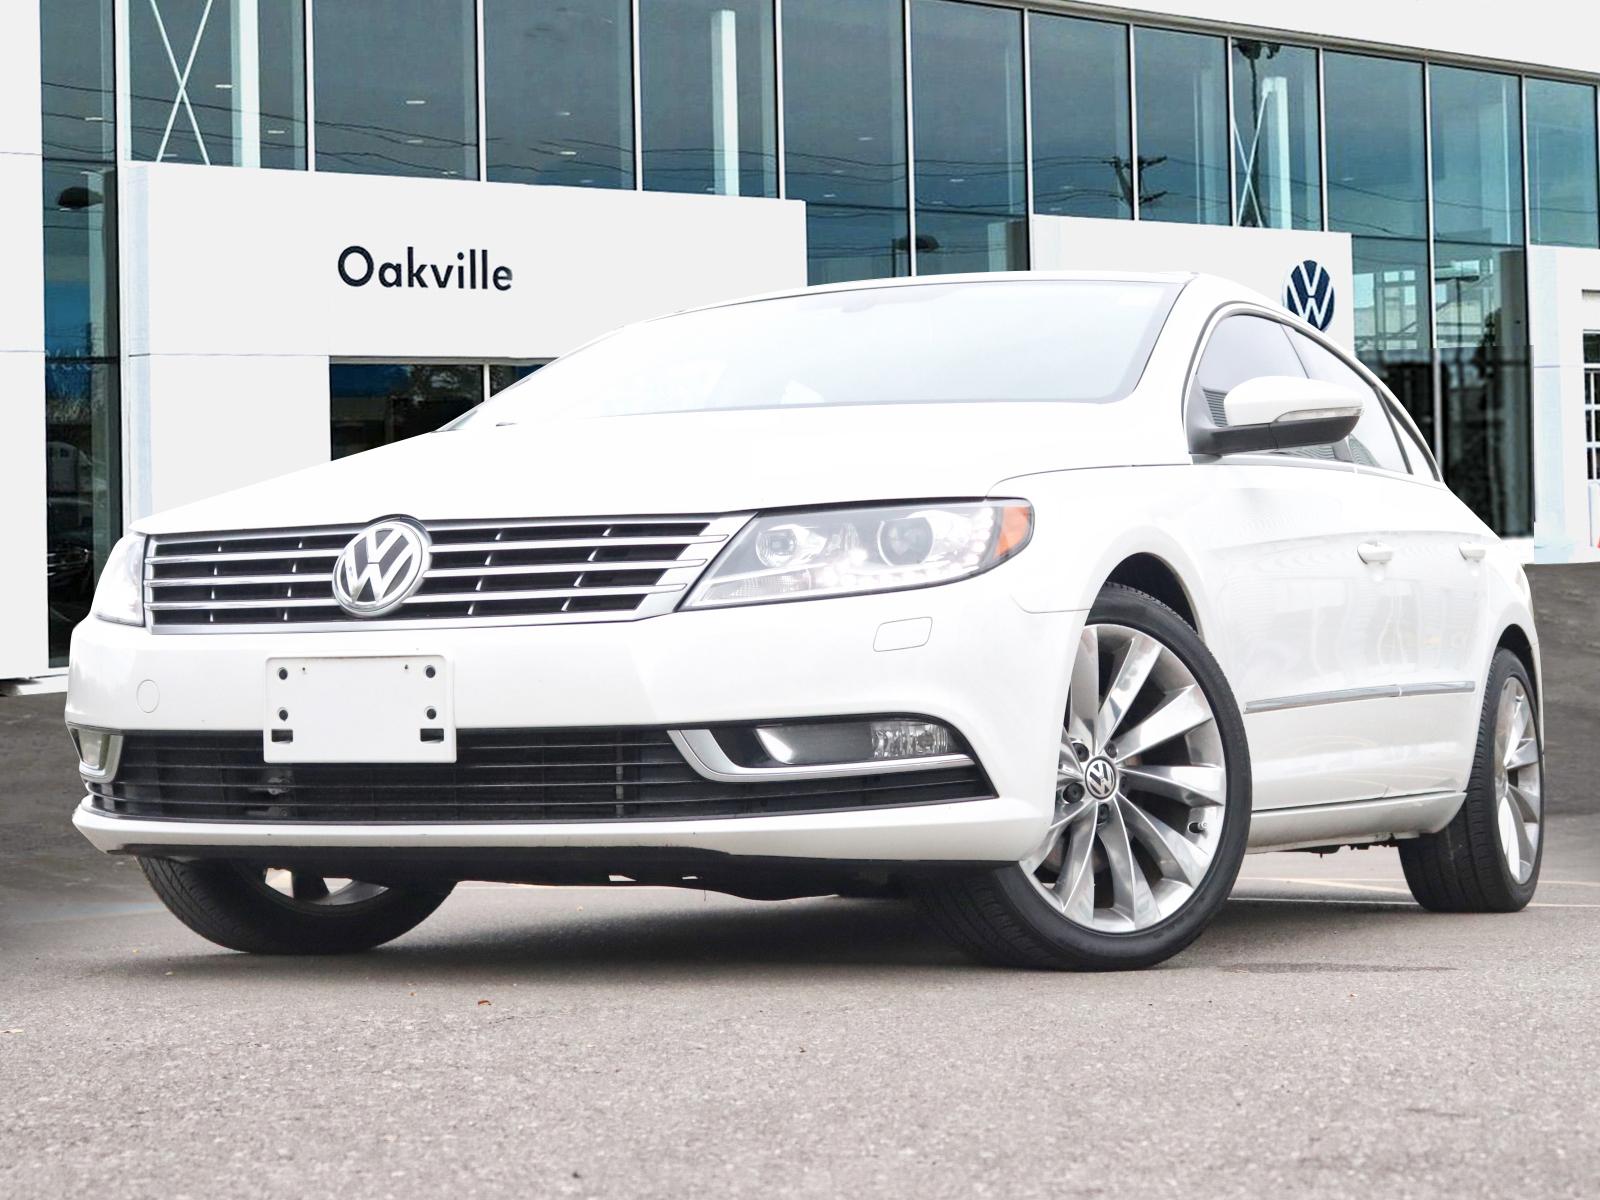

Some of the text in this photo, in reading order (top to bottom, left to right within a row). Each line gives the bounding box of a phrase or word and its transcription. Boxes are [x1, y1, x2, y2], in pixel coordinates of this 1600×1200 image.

[337, 245, 513, 291] Oakville
[1285, 259, 1335, 331] VW
[338, 523, 421, 607] VW
[1087, 759, 1115, 798] VW
